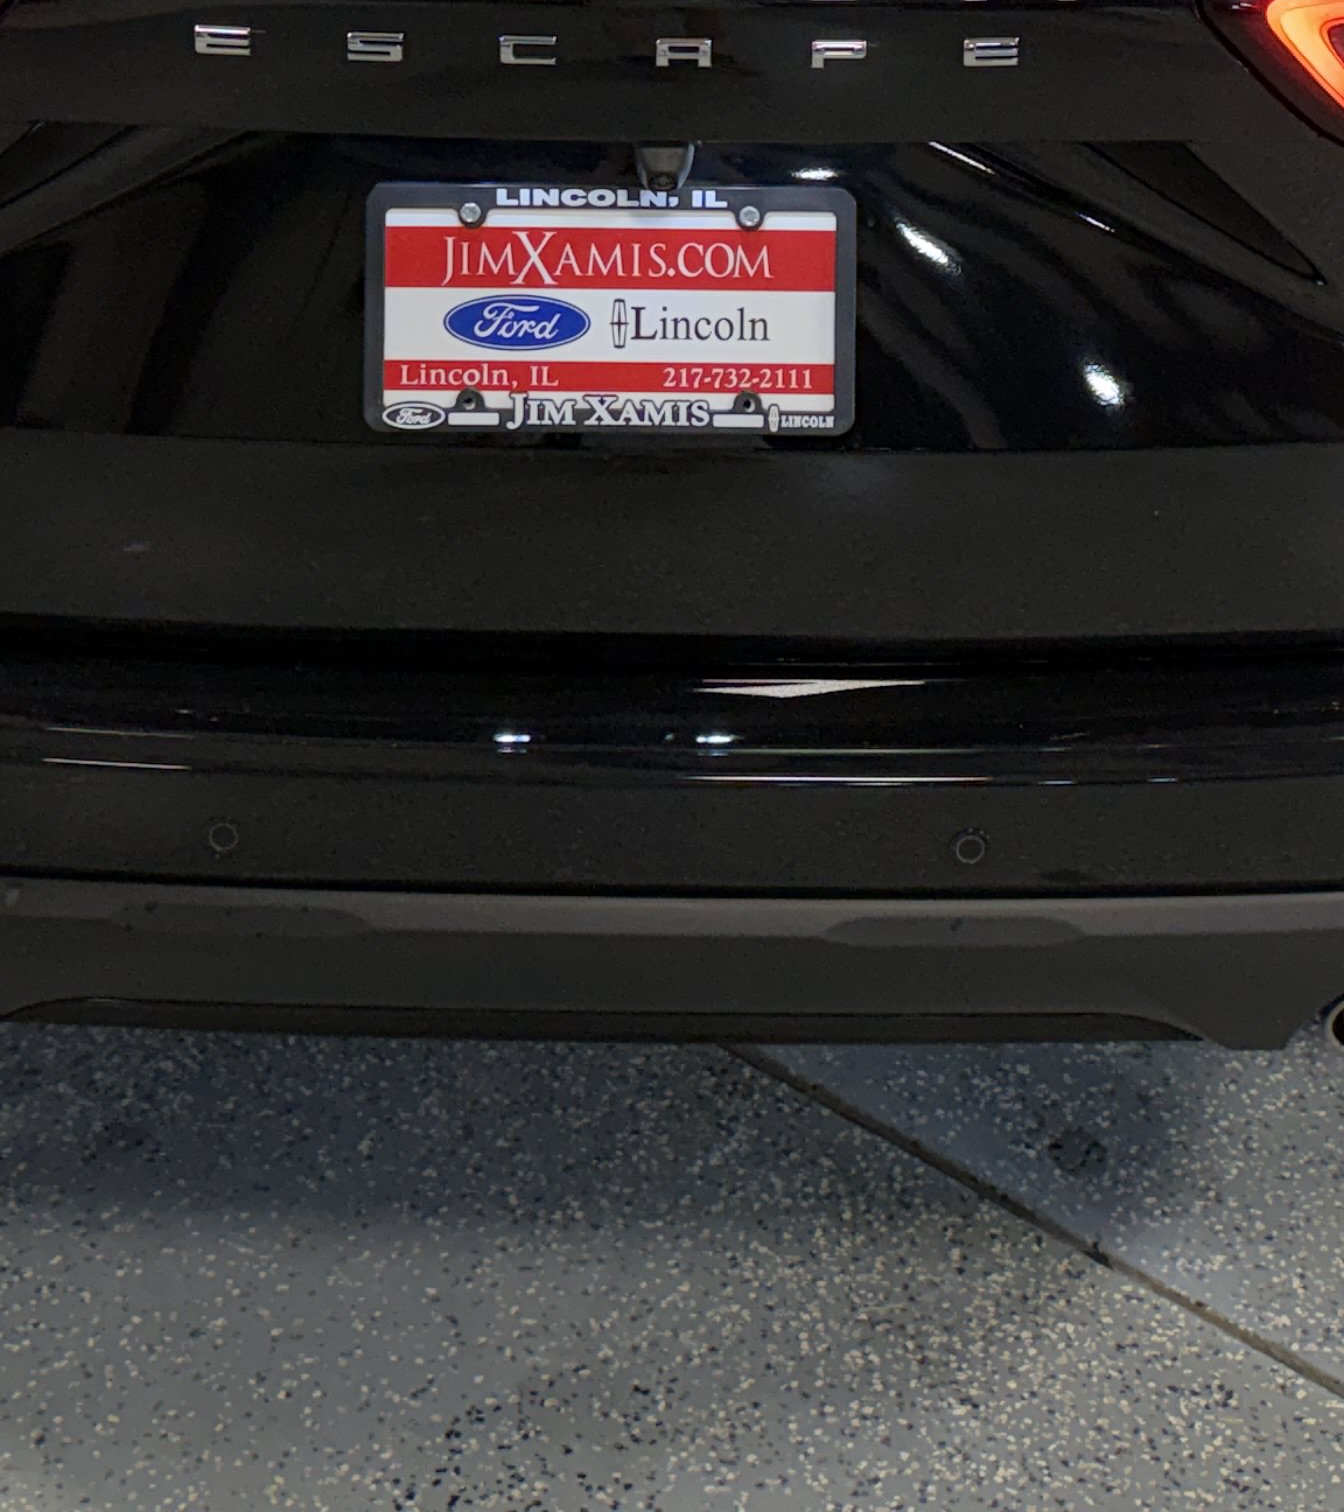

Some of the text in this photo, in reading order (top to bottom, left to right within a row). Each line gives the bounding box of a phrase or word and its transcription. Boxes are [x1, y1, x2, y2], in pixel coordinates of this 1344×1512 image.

[193, 23, 1021, 69] ESCAPE
[496, 188, 728, 208] LINCOLN, IL
[441, 231, 773, 285] JIMXAMIS.COM
[474, 303, 770, 341] Ford Lincoln
[399, 363, 559, 389] Lincoln, IL
[663, 367, 813, 390] 217-732-2111
[395, 392, 835, 430] Ford JIM XAMIS LINCOLN
